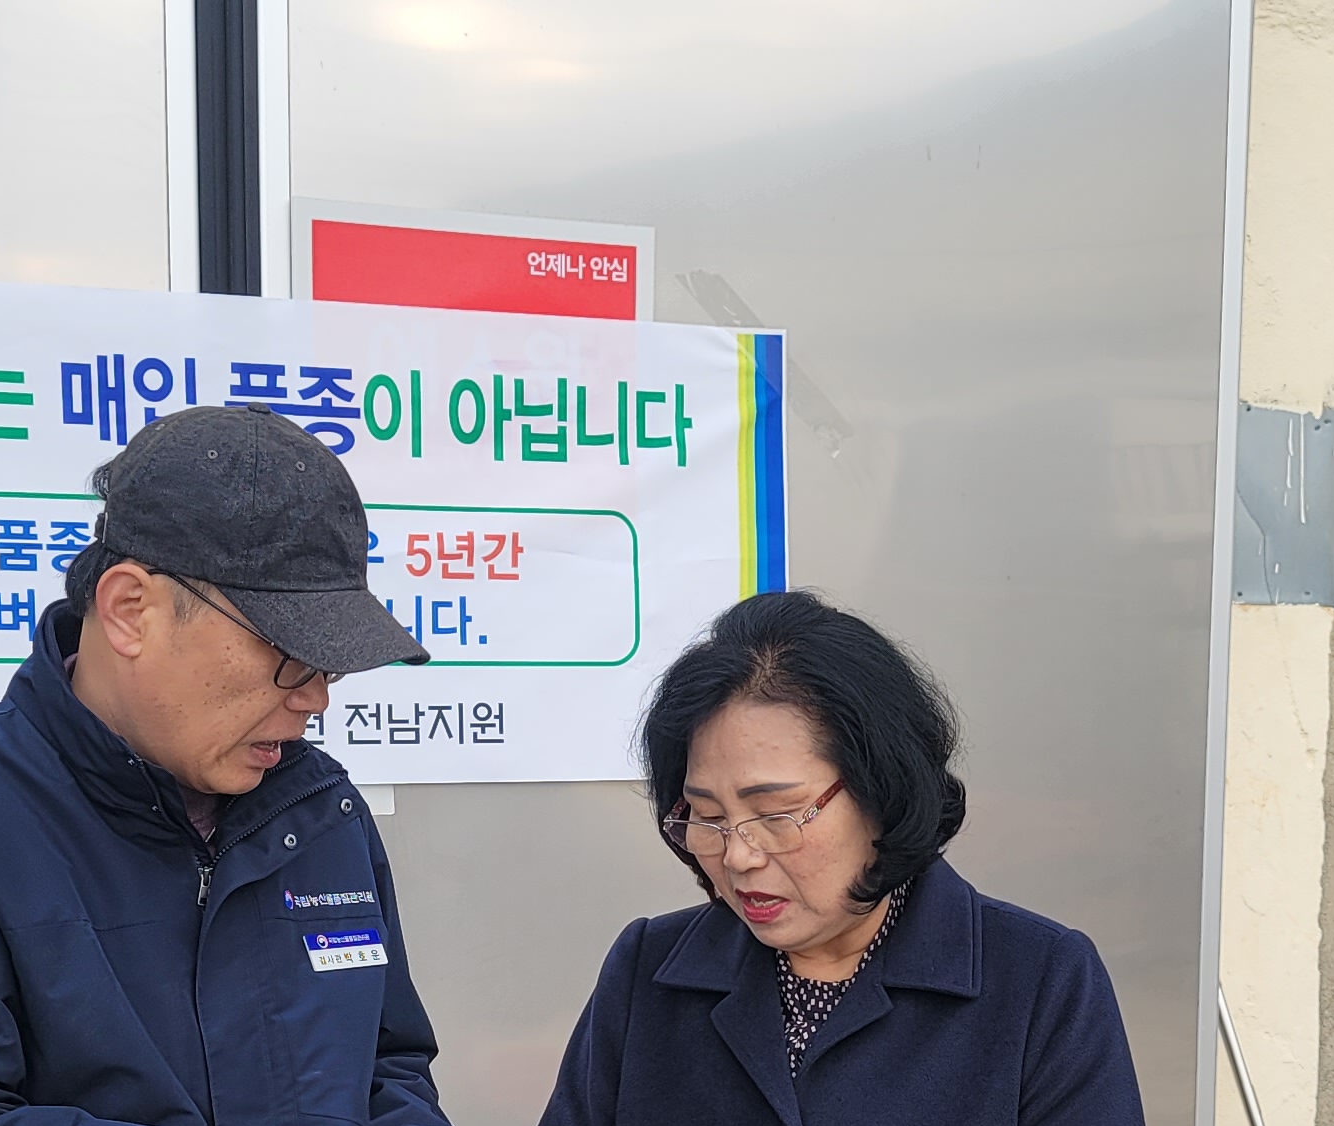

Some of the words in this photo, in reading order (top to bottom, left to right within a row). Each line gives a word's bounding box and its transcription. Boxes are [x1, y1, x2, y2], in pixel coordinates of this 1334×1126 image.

[527, 251, 586, 280] 언제나
[590, 256, 628, 284] 안심
[449, 374, 693, 467] 아닙니다
[405, 531, 524, 580] 5년간
[345, 702, 505, 745] 전남지원
